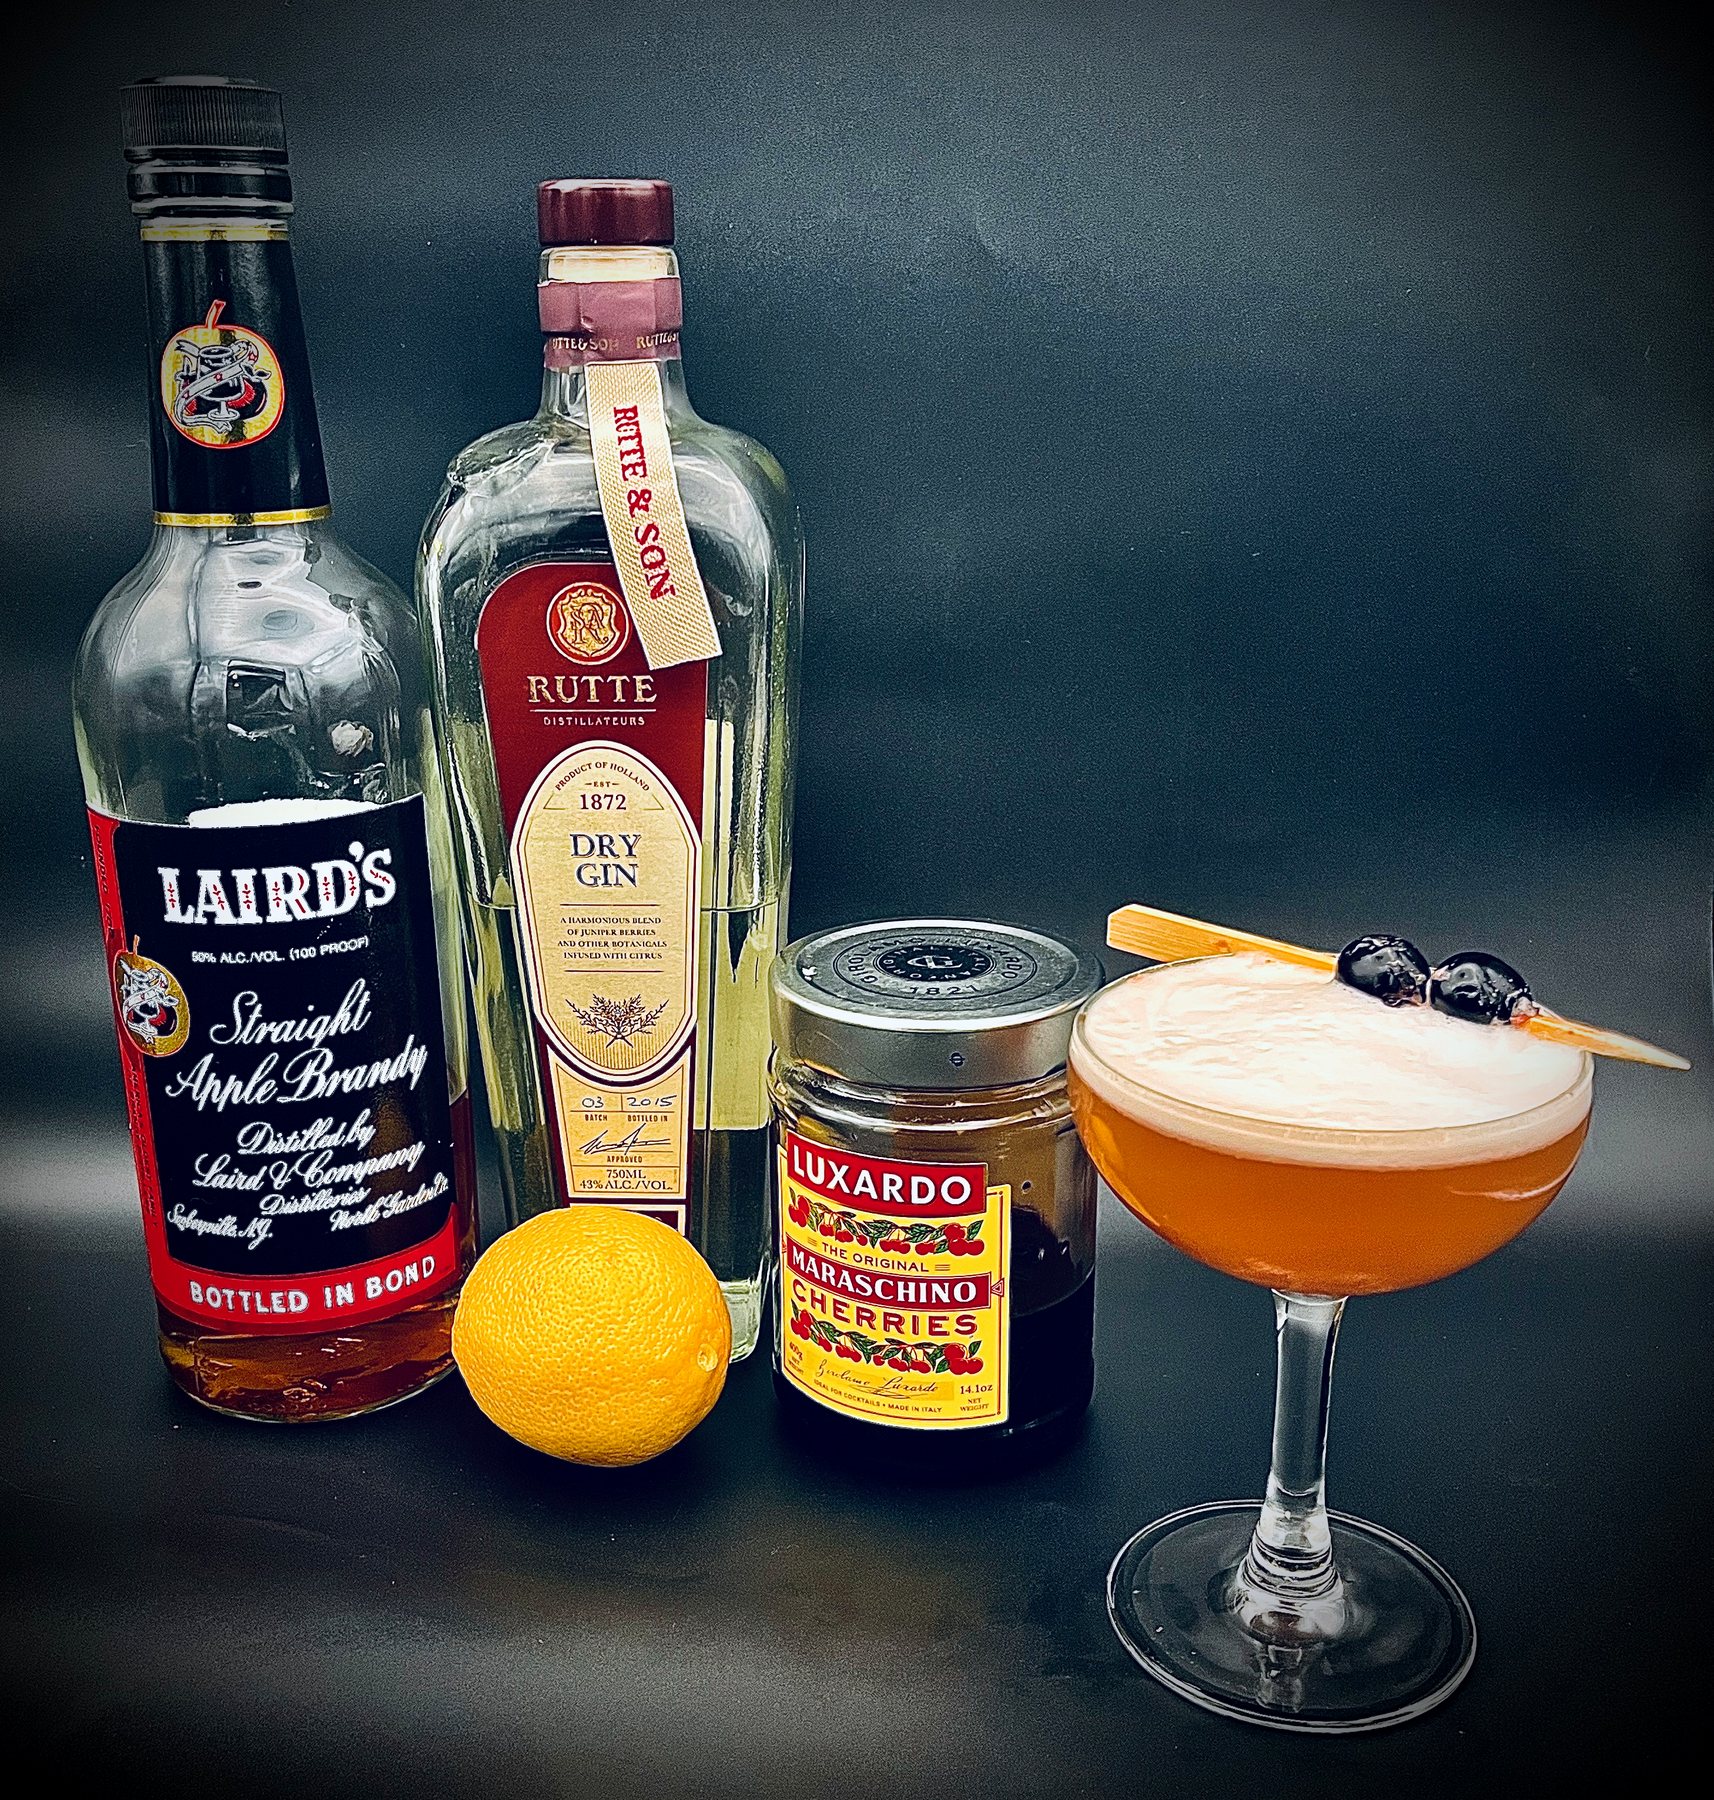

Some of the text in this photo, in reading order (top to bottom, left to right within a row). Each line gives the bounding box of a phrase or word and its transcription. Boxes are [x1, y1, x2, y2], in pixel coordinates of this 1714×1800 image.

[614, 405, 677, 600] RUTTE & SON
[527, 675, 658, 703] RUTTE
[543, 716, 646, 727] DISTILLATEURS
[555, 761, 650, 791] PRODUCT OF HOLLAND
[580, 793, 627, 810] 1872
[570, 833, 641, 859] DRY
[157, 841, 397, 925] LAIRD'S
[575, 863, 639, 887] GIN
[569, 916, 630, 924] HARMONIOUS
[580, 929, 617, 937] JUNIPER
[289, 947, 317, 961] (100
[320, 935, 370, 955] PROOF)
[908, 984, 980, 995] 1821
[209, 977, 372, 1049] Straight
[165, 1034, 428, 1112] Apple Brandy
[582, 1096, 604, 1108] 03
[627, 1095, 677, 1107] 2015
[237, 1108, 376, 1155] Distilled by
[192, 1153, 267, 1190] Laird
[295, 1141, 426, 1188] Company
[606, 1169, 646, 1179] 750ML
[793, 1145, 971, 1205] LUXARDO
[580, 1180, 604, 1189] 43%
[259, 1187, 372, 1215] Distilleries
[822, 1241, 929, 1272] THE ORIGINAL
[189, 1255, 436, 1312] BOTTLED IN BOND
[792, 1245, 977, 1303] MARASCHINO
[792, 1278, 978, 1336] CHERRIES
[814, 1379, 829, 1392] IDEAL
[830, 1388, 843, 1397] FOR
[843, 1392, 881, 1407] COCKTAILS
[887, 1403, 909, 1411] MADE
[959, 1403, 990, 1412] WEIGHT
